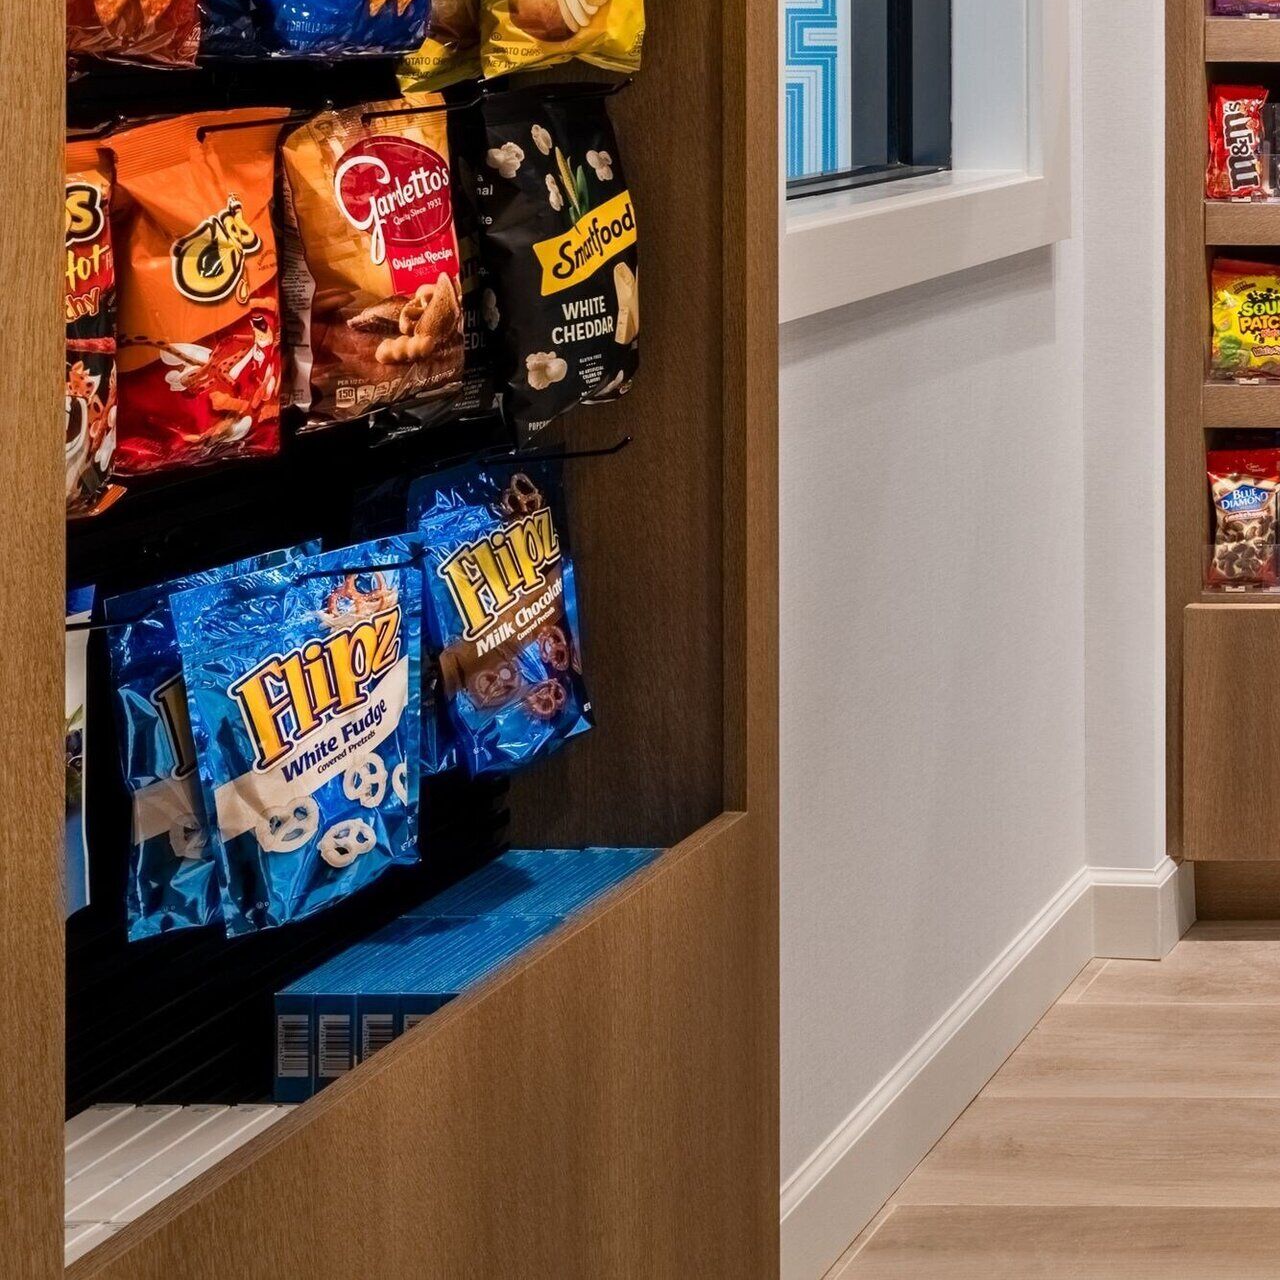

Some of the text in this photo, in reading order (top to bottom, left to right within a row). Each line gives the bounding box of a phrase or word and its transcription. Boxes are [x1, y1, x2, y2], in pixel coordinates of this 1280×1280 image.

[336, 154, 451, 266] Gardetto's
[551, 204, 636, 281] Smartfood
[551, 316, 614, 345] CHEDDAR
[562, 294, 606, 320] WHITE
[1221, 493, 1268, 510] DIAMOND
[1233, 488, 1256, 500] BLUE
[440, 508, 561, 638] Flipz
[231, 606, 404, 773] Flipz
[281, 696, 390, 784] White Fudge
